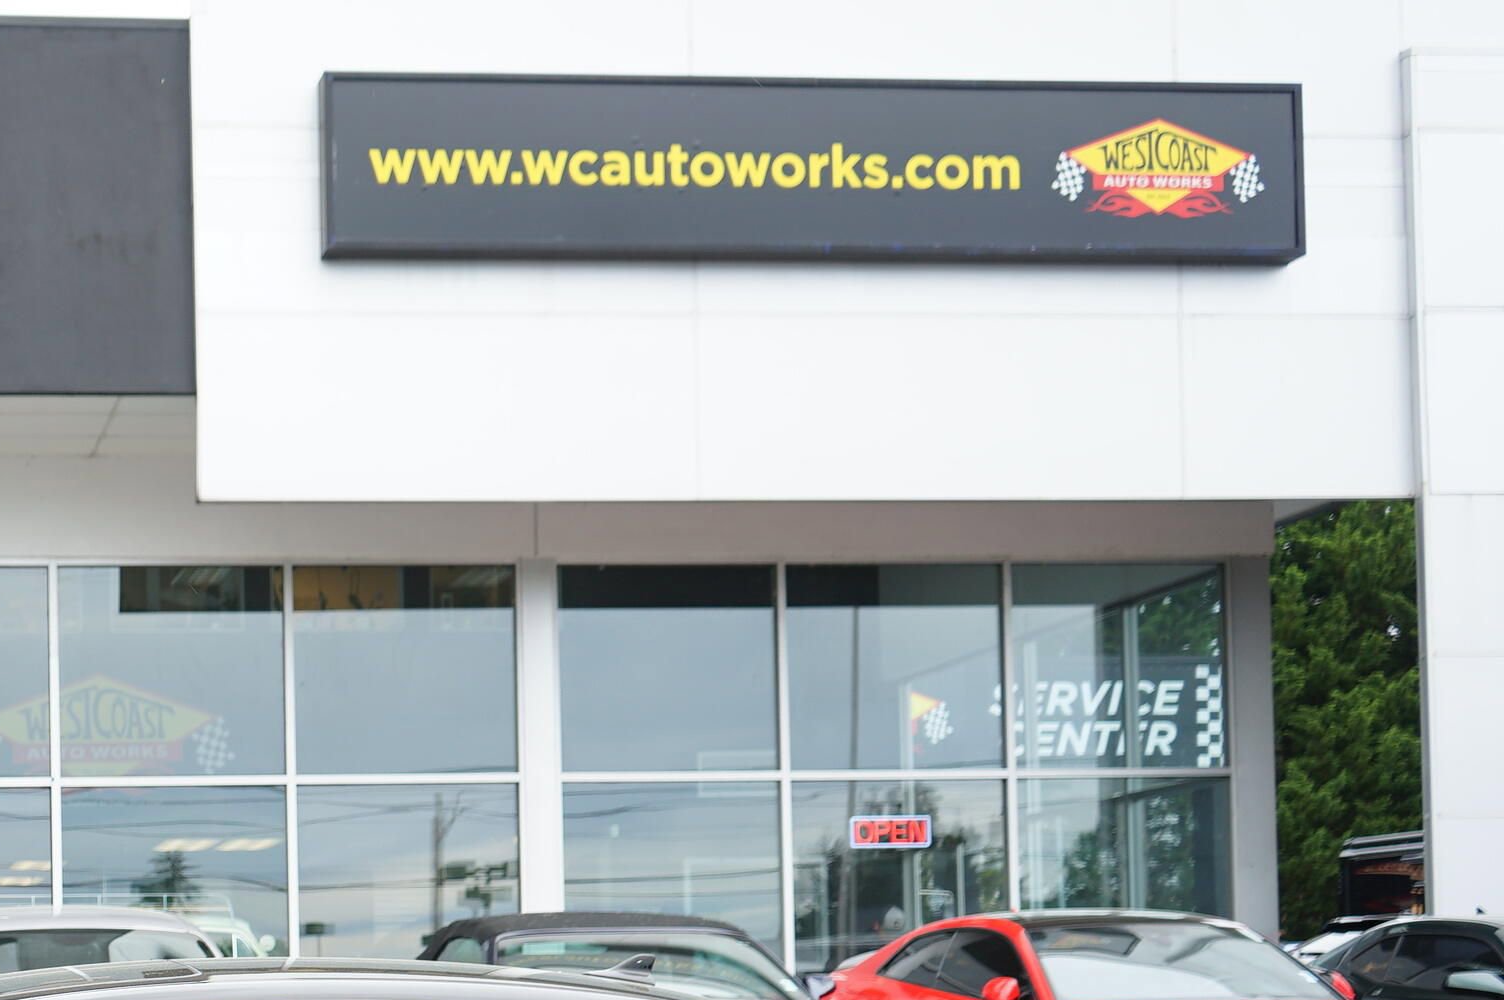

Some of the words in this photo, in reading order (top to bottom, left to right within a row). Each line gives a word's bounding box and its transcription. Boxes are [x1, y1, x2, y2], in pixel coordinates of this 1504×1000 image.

[368, 143, 1021, 191] www.wcautoworks.com
[1104, 175, 1149, 189] AUTO
[1153, 176, 1214, 190] WORKS
[17, 686, 176, 741] WSTCOAST
[27, 744, 86, 759] ATO
[854, 820, 928, 843] OPEN
